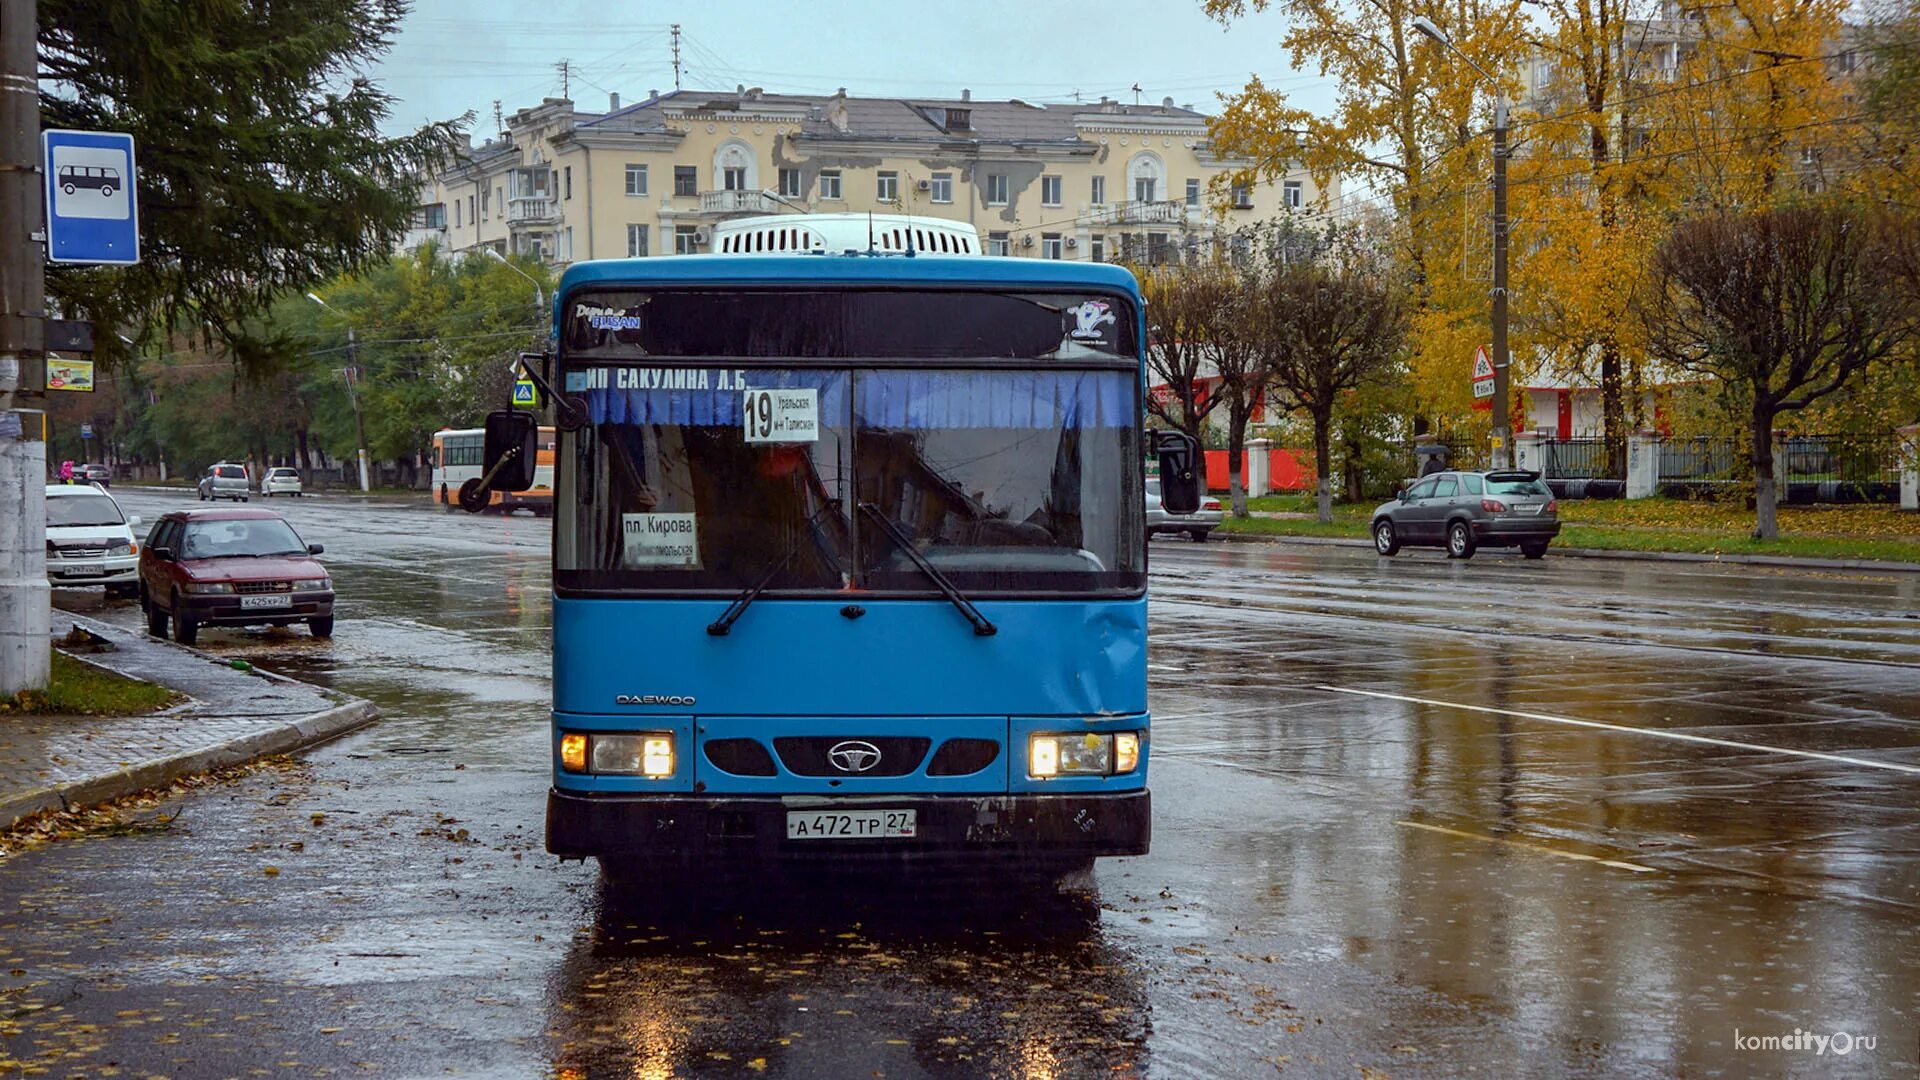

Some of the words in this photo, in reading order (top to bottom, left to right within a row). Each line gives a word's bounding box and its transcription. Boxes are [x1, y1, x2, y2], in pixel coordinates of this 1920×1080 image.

[586, 368, 608, 389] ИП
[617, 368, 708, 389] САКУЛИНА
[745, 391, 772, 438] 19
[625, 520, 644, 534] пл.
[647, 516, 692, 538] Кирова
[616, 694, 697, 706] DAEWOO
[887, 813, 908, 828] 27
